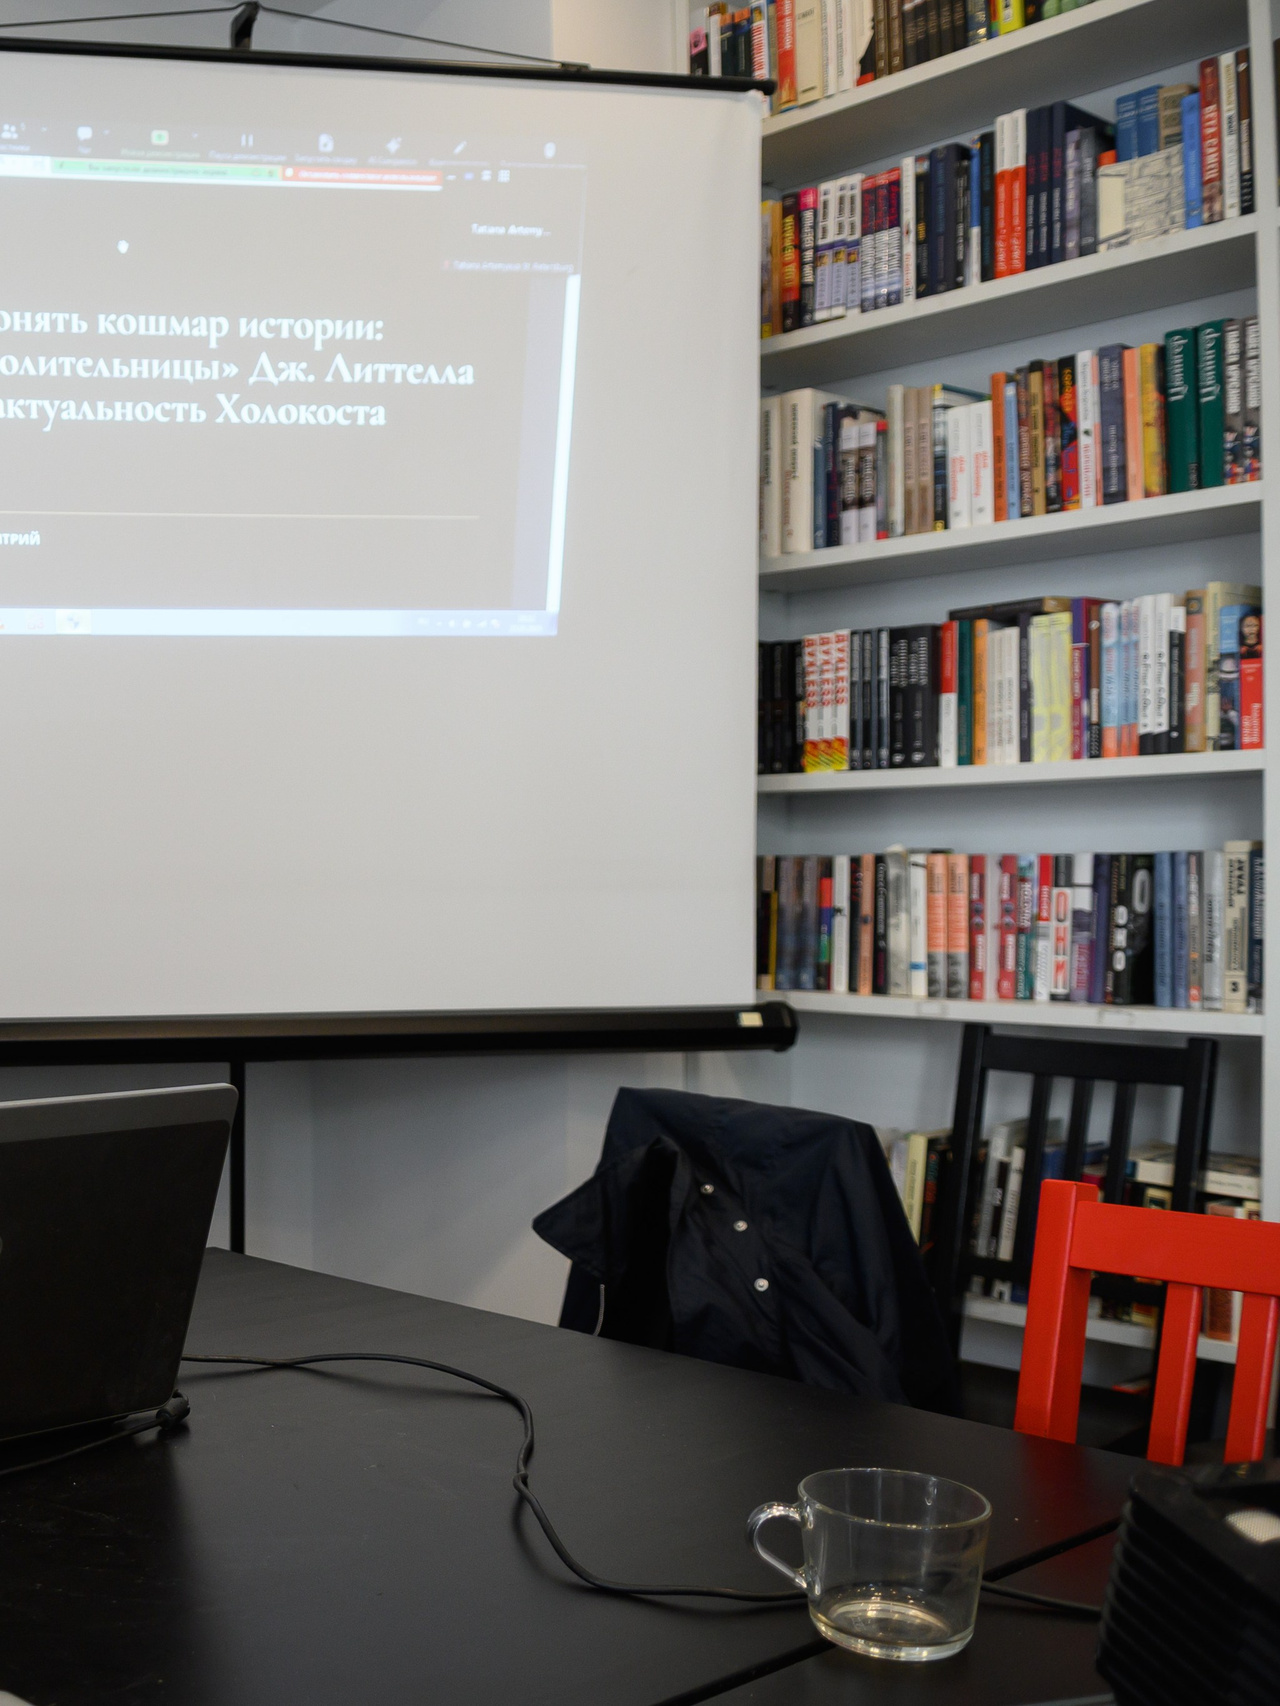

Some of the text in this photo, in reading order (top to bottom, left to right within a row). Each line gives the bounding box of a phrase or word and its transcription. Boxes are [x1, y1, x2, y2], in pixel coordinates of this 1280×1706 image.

[96, 308, 228, 349] кошмар
[238, 312, 385, 350] истории:
[249, 352, 315, 387] Дж.
[324, 353, 475, 387] Литтелла
[214, 394, 387, 427] Холокоста
